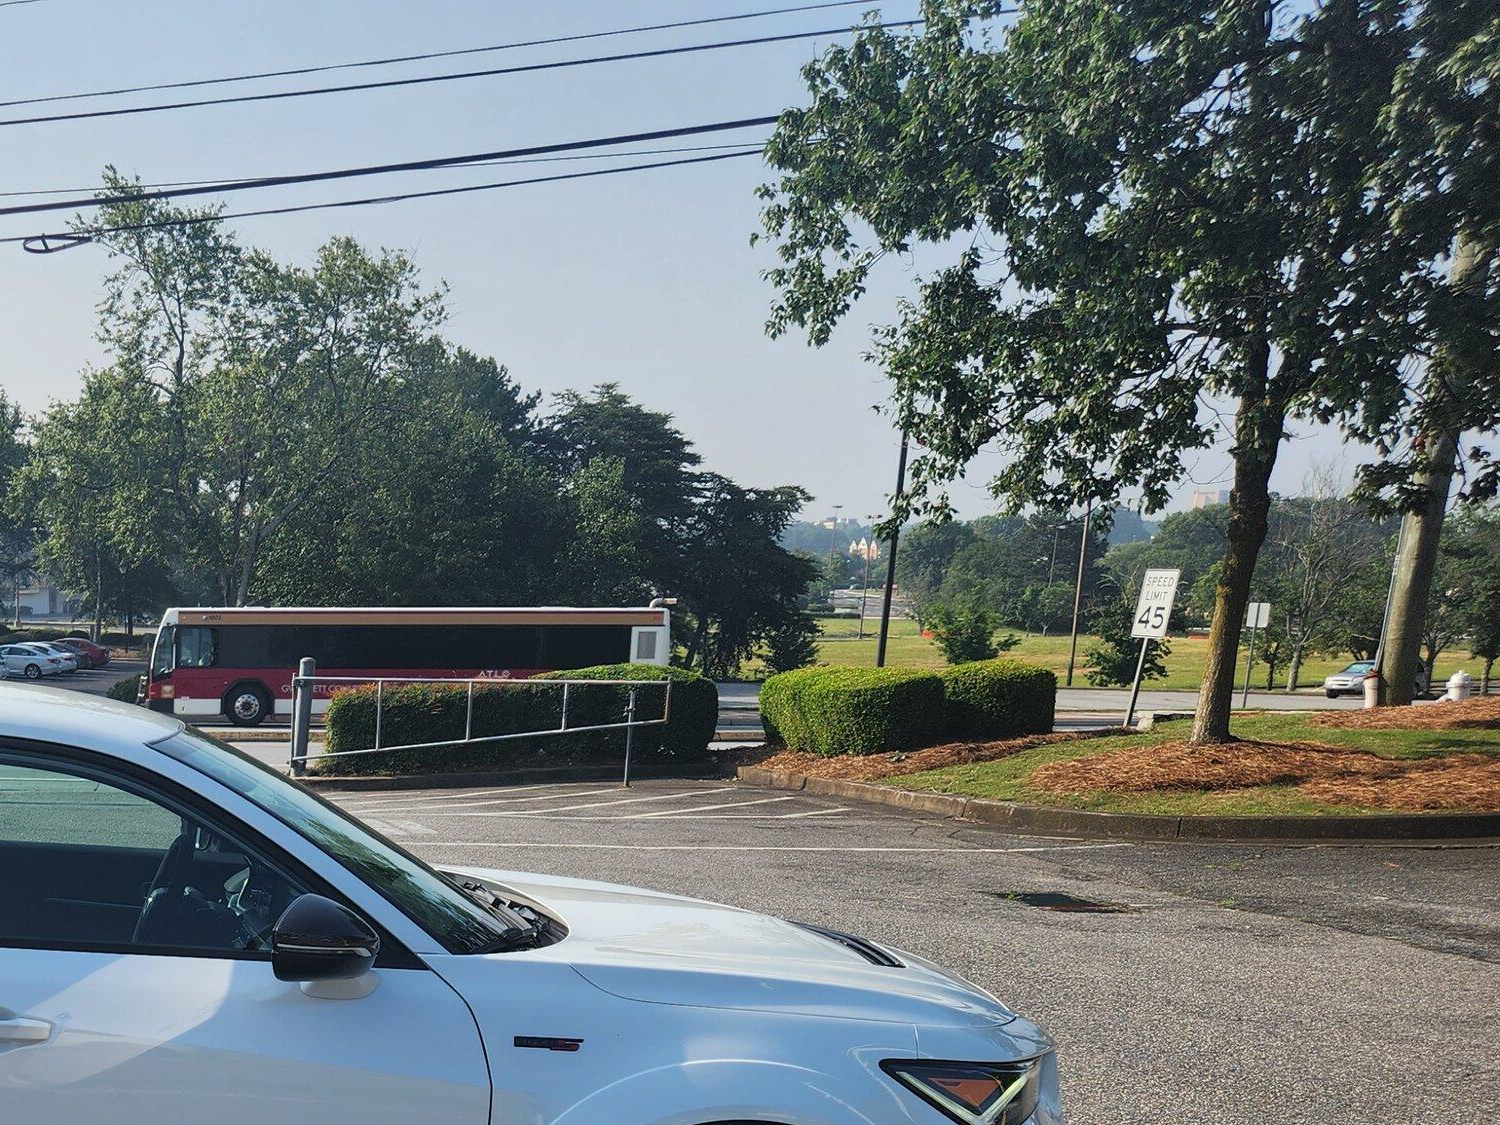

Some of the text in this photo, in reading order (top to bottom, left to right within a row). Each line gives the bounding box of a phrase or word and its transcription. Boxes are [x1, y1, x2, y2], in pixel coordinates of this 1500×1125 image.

[1146, 576, 1175, 587] SPEED
[1145, 591, 1168, 601] LIMIT
[1138, 606, 1166, 629] 45
